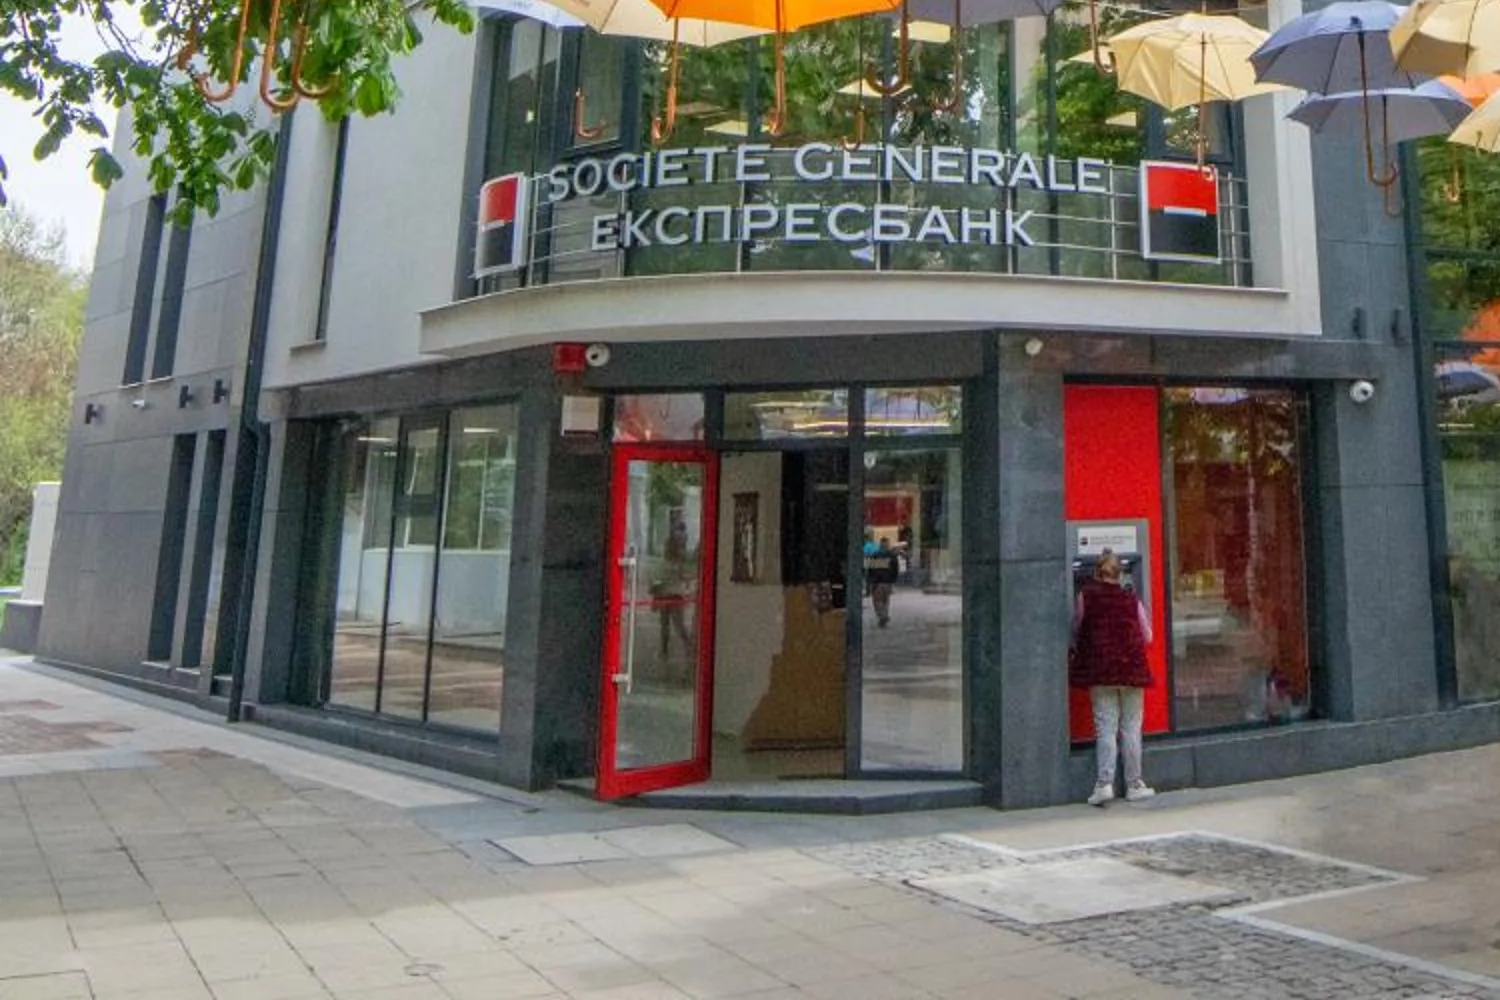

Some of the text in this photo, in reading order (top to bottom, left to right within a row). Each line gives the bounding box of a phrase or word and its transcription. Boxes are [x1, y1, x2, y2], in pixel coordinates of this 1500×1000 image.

[548, 142, 1107, 201] SOCIETE GENERALE
[591, 202, 1035, 250] ЕКСПРЕСБАНК
